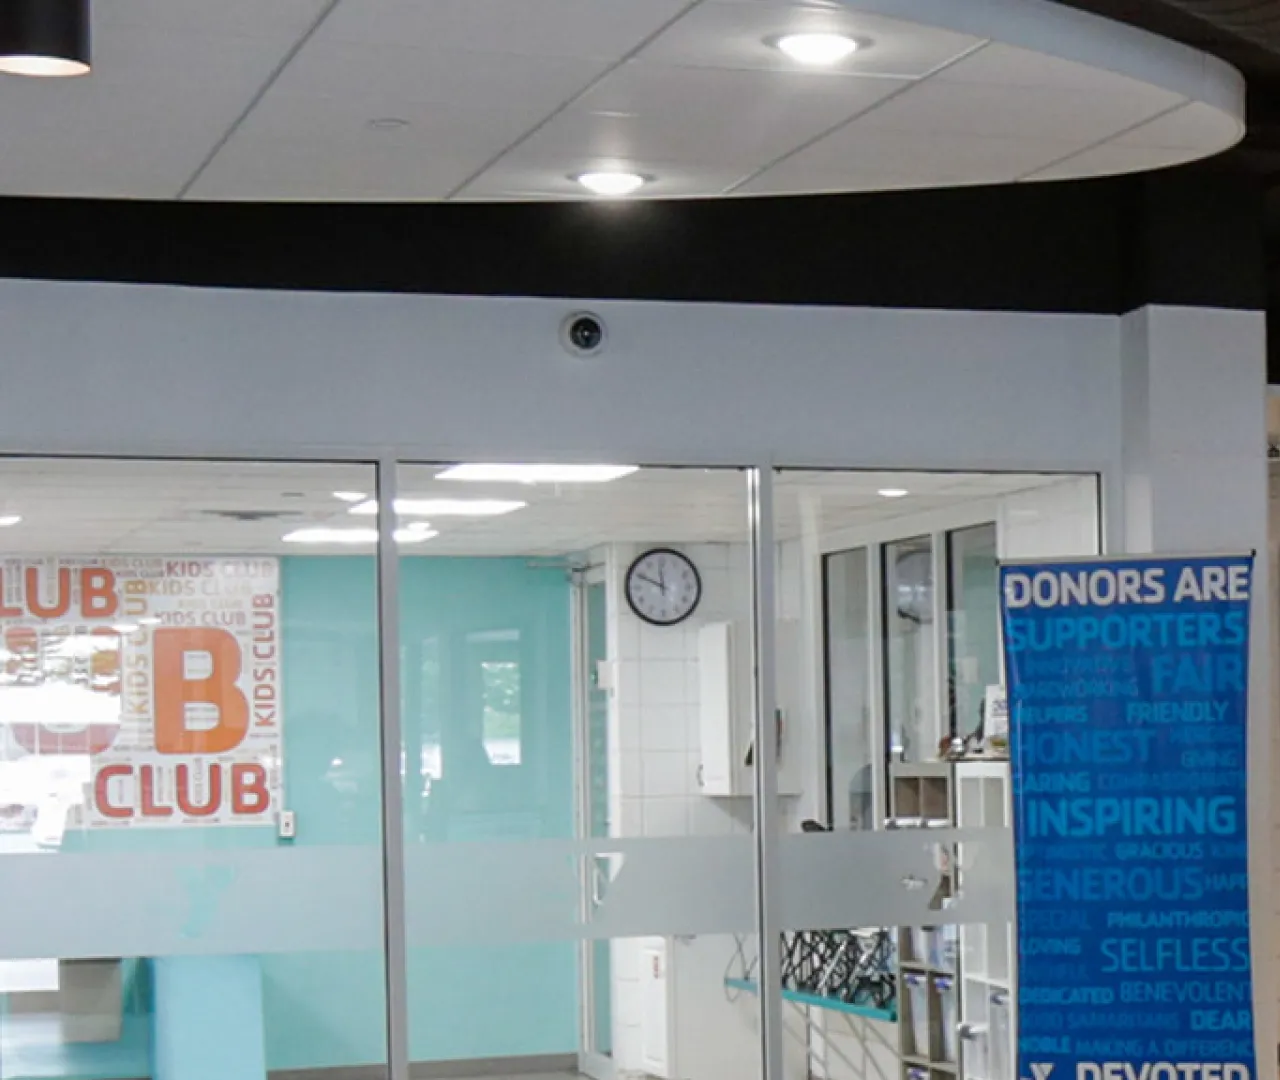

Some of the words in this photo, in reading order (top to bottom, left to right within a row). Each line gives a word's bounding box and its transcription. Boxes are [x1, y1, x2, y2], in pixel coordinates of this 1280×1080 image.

[166, 560, 213, 577] KIDS
[1004, 568, 1165, 608] DONORS
[1173, 565, 1249, 603] ARE
[1008, 611, 1245, 651] SUPPORTERS
[1151, 653, 1243, 693] FAIR
[1125, 700, 1229, 723] FRIENDLY
[1018, 729, 1157, 767] HONEST
[94, 762, 270, 818] CLUB
[1026, 795, 1237, 838] INSPIRING
[1100, 936, 1250, 973] SELFLESS
